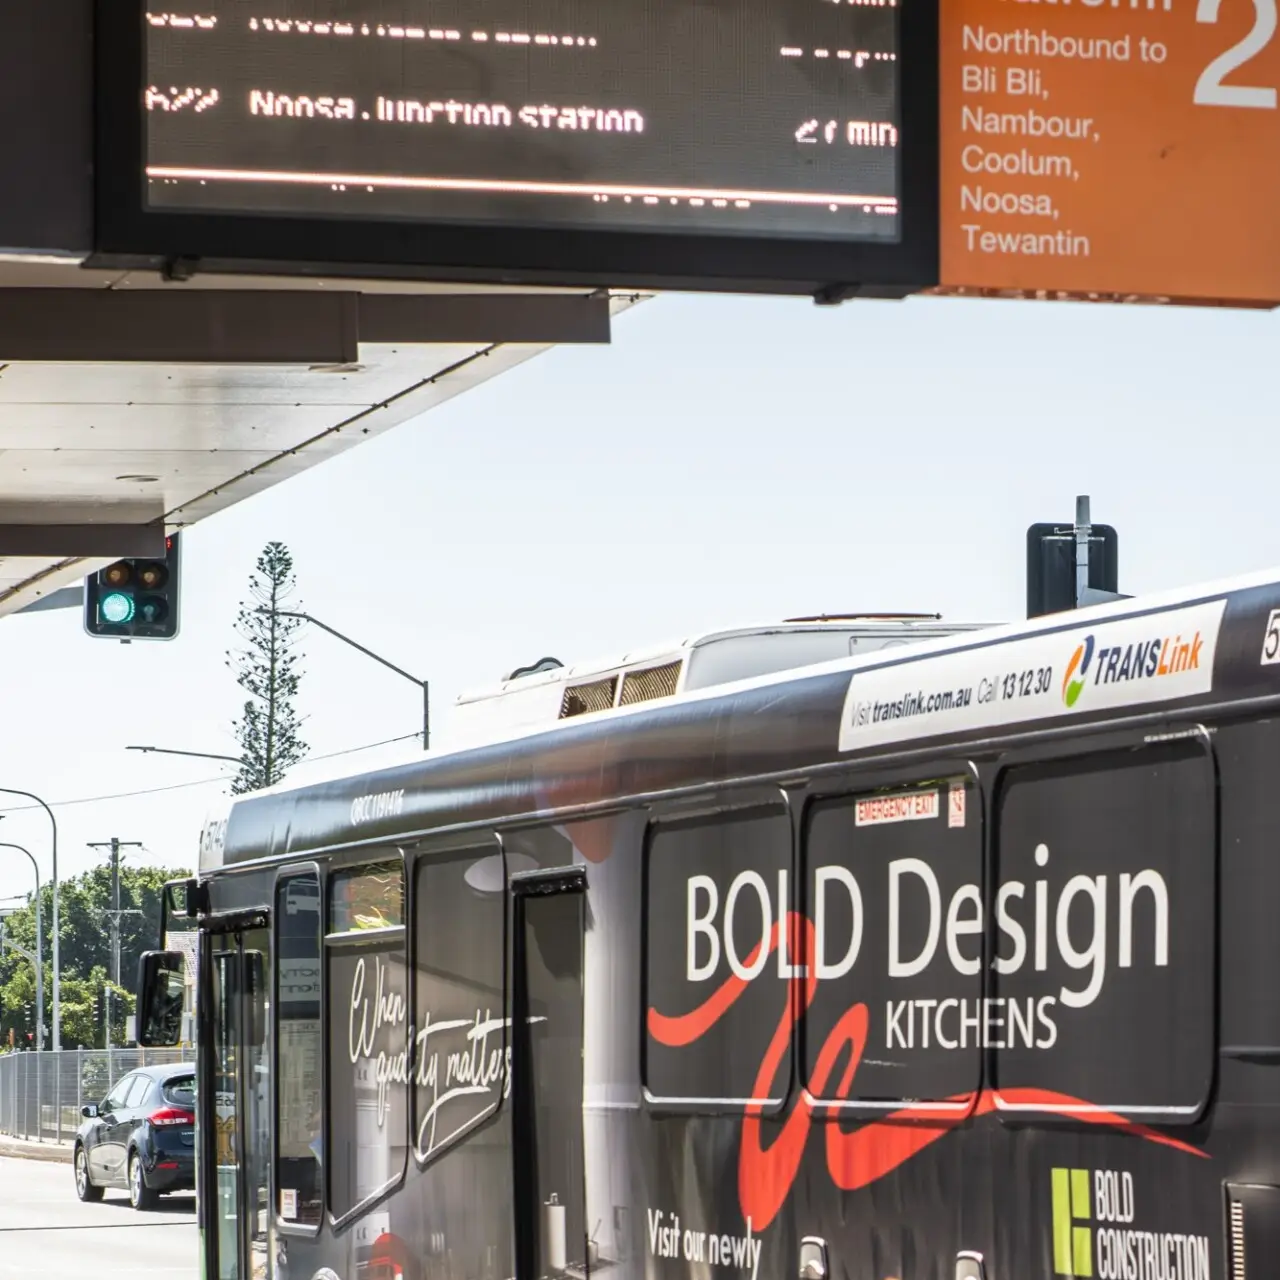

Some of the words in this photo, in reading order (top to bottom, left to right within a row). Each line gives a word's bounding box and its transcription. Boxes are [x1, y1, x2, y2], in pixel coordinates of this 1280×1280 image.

[961, 25, 1130, 61] Northbound
[1139, 41, 1168, 63] to
[1193, 0, 1278, 109] 2
[961, 65, 996, 93] Bli
[1006, 68, 1049, 100] Bli,
[846, 120, 899, 147] min
[961, 106, 1100, 142] Nambour,
[961, 145, 1080, 181] Coolum,
[960, 185, 1059, 220] Noosa,
[961, 224, 1091, 256] Tewantin
[1094, 630, 1204, 686] TRANSLink
[851, 702, 872, 728] Visit
[872, 687, 971, 724] translink.com.au
[977, 675, 999, 705] Call
[1002, 671, 1016, 700] 13
[1034, 666, 1053, 694] 30
[858, 796, 912, 822] EMERGENCY
[916, 792, 935, 815] EXIT
[687, 864, 864, 982] BOLD
[887, 842, 1169, 1008] Design
[350, 955, 406, 1064] When
[885, 996, 1058, 1049] KITCHENS
[1094, 1169, 1134, 1223] BOLD
[647, 1208, 680, 1258] Visit
[683, 1227, 705, 1263] our
